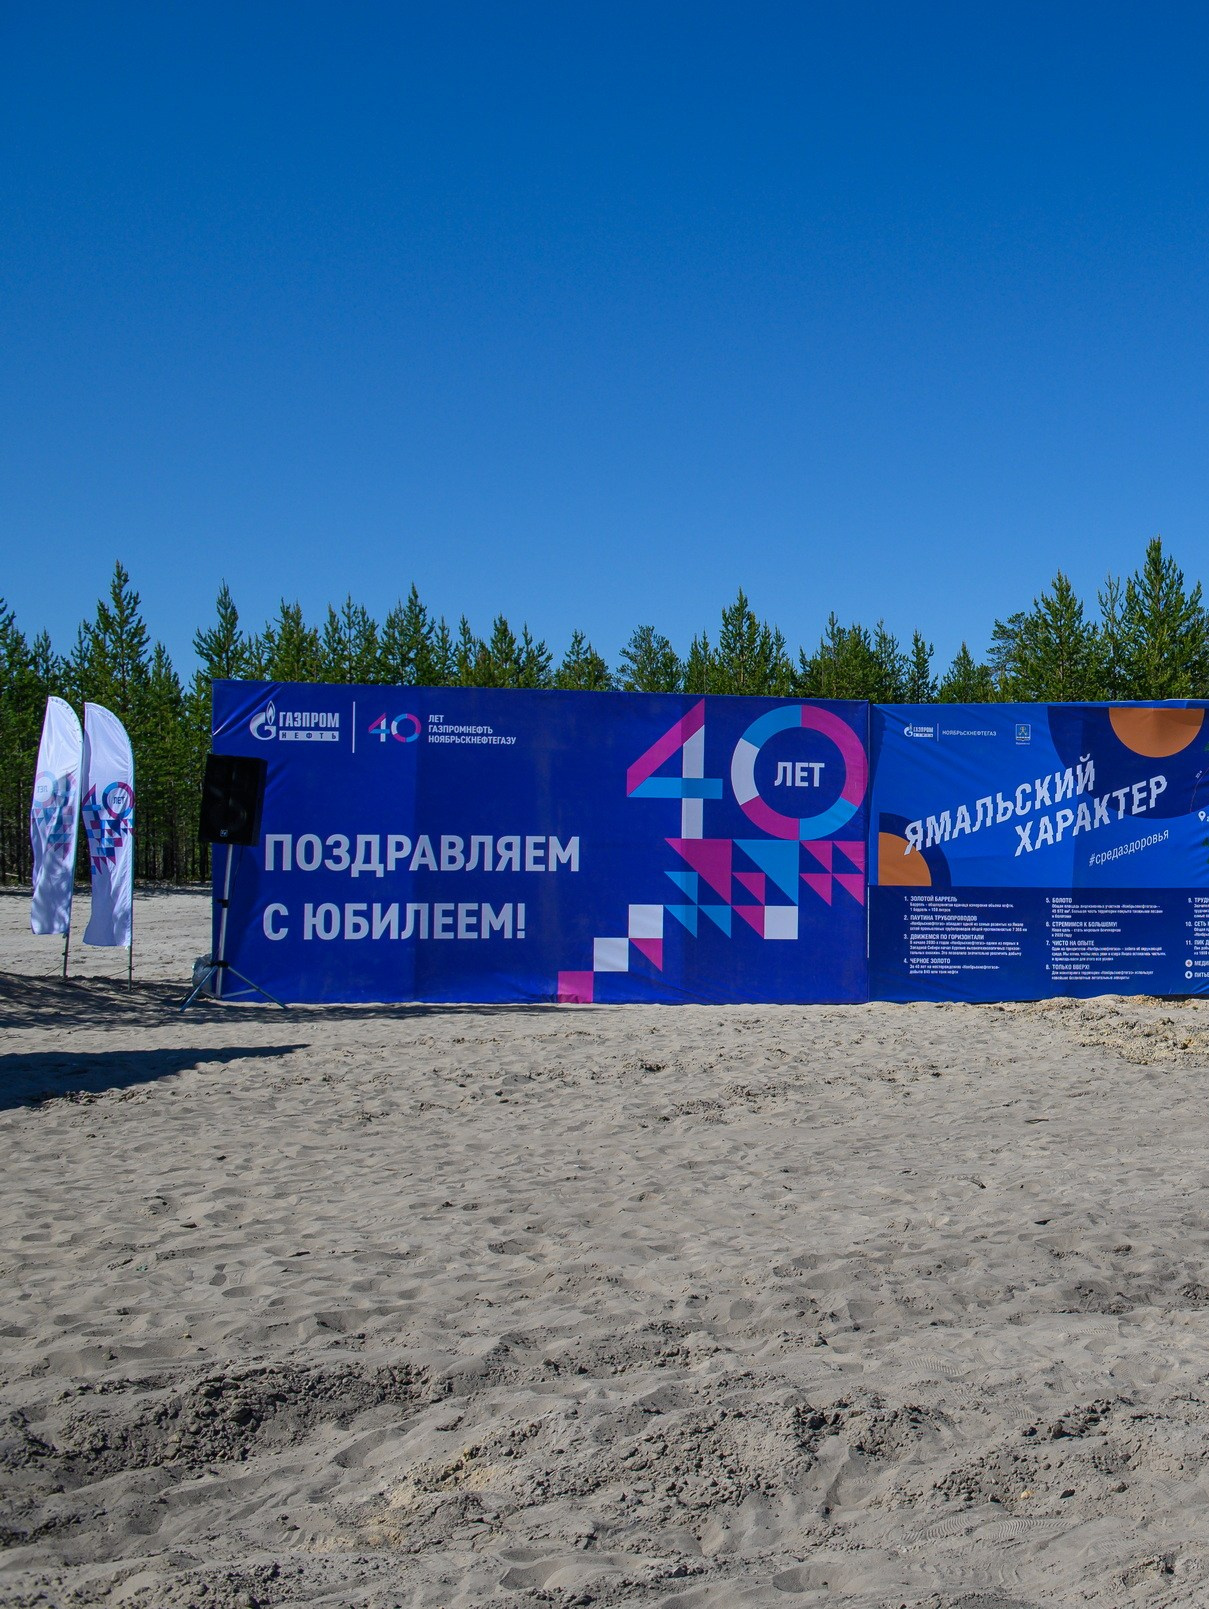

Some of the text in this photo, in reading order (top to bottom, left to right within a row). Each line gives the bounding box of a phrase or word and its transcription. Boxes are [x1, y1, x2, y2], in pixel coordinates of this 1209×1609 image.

[279, 712, 340, 728] ГАЗПРОМ
[368, 712, 422, 743] 40
[428, 714, 444, 722] ЛЕТ
[428, 724, 493, 734] ГАЗПРОМНЕФТЬ
[281, 731, 337, 740] НЕФТЬ
[428, 734, 516, 744] НОЯБРЬСКНЕФТЕГАЗУ
[626, 698, 868, 840] 40
[774, 761, 825, 788] ЛЕТ
[904, 753, 1096, 856] ЯМАЛЬСКИЙ
[1014, 774, 1168, 856] ХАРАКТЕР
[264, 833, 580, 878] ПОЗДРАВЛЯЕМ
[1088, 830, 1169, 867] #средаздоровья
[263, 902, 526, 940] С ЮБИЛЕЕМ!
